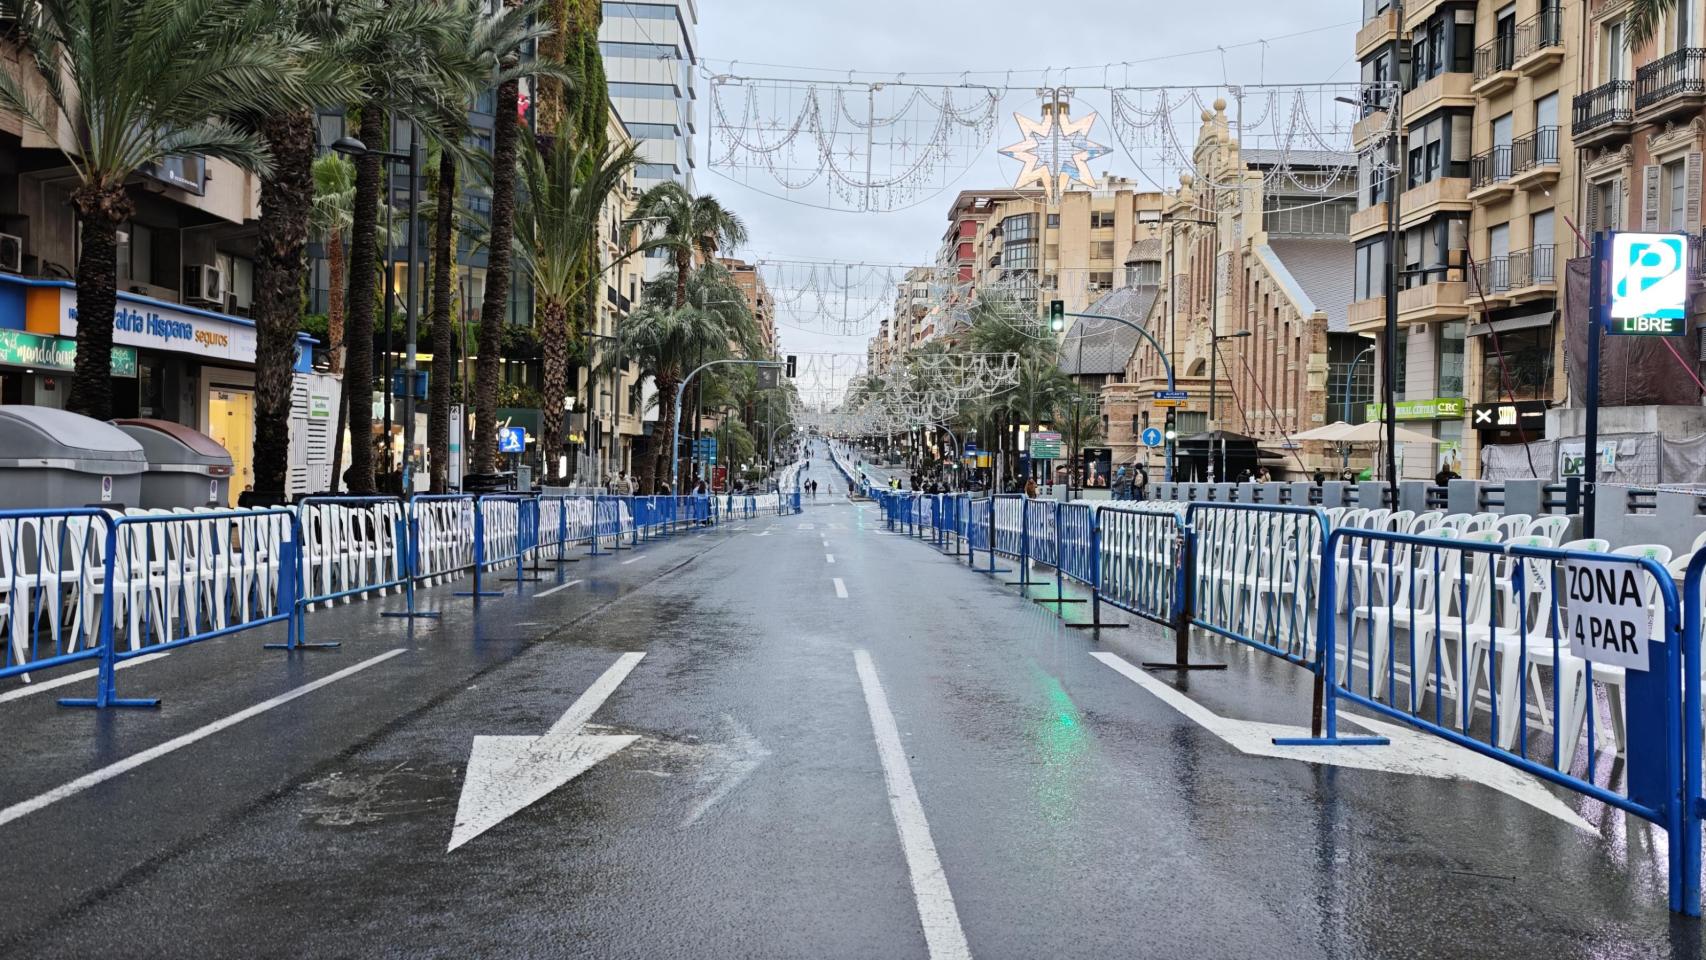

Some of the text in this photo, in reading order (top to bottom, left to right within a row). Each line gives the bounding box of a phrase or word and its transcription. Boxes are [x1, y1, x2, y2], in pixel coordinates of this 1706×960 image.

[113, 307, 144, 334] atria
[146, 312, 193, 343] Hispana
[195, 331, 228, 348] seguros
[1624, 317, 1672, 332] LIBRE
[450, 405, 460, 414] 23
[1437, 402, 1459, 412] CRC
[1568, 565, 1642, 608] ZONA
[1575, 614, 1585, 646] 4
[1589, 616, 1639, 655] PAR
